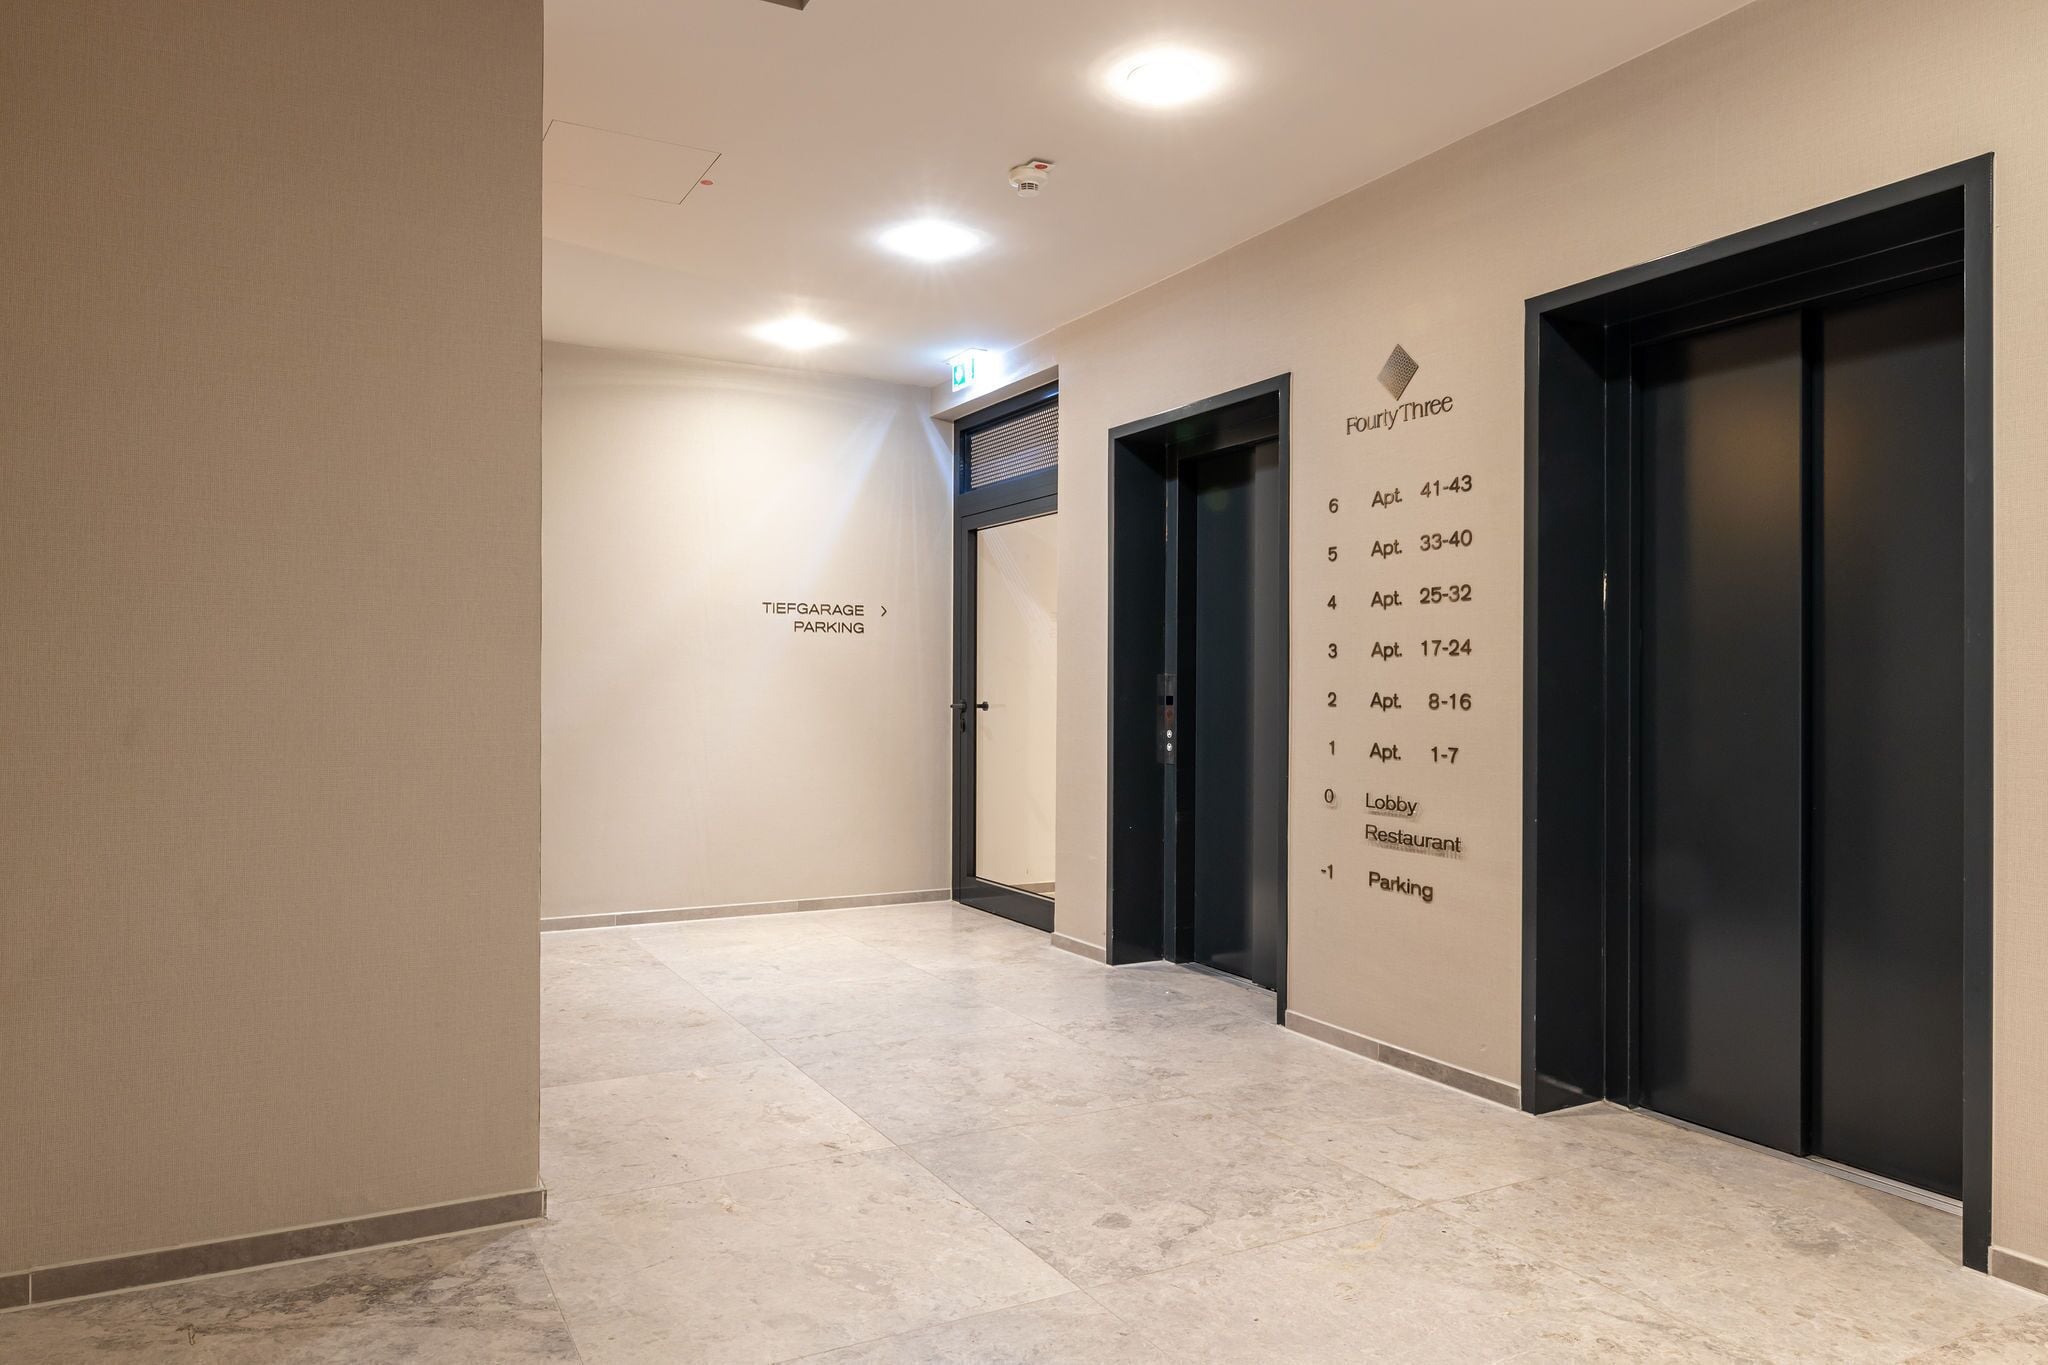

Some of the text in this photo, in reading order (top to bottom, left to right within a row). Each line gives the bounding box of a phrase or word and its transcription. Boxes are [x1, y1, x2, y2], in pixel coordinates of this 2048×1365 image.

[1328, 475, 1472, 513] 6 Apt. 41-43
[1327, 529, 1472, 562] 5 Apt. 33-40
[762, 602, 864, 616] TIEFGARAGE
[1326, 584, 1471, 610] 4 Apt. 25-32
[794, 621, 864, 634] PARKING
[1327, 639, 1472, 661] 3 Apt. 17-24
[1327, 692, 1471, 712] 2 Apt. 8-16
[1328, 740, 1459, 764] 1 Apt. 1-7
[1324, 789, 1417, 816] 0 Lobby
[1365, 824, 1461, 853] Restaurant
[1321, 864, 1433, 904] -1 Parking
